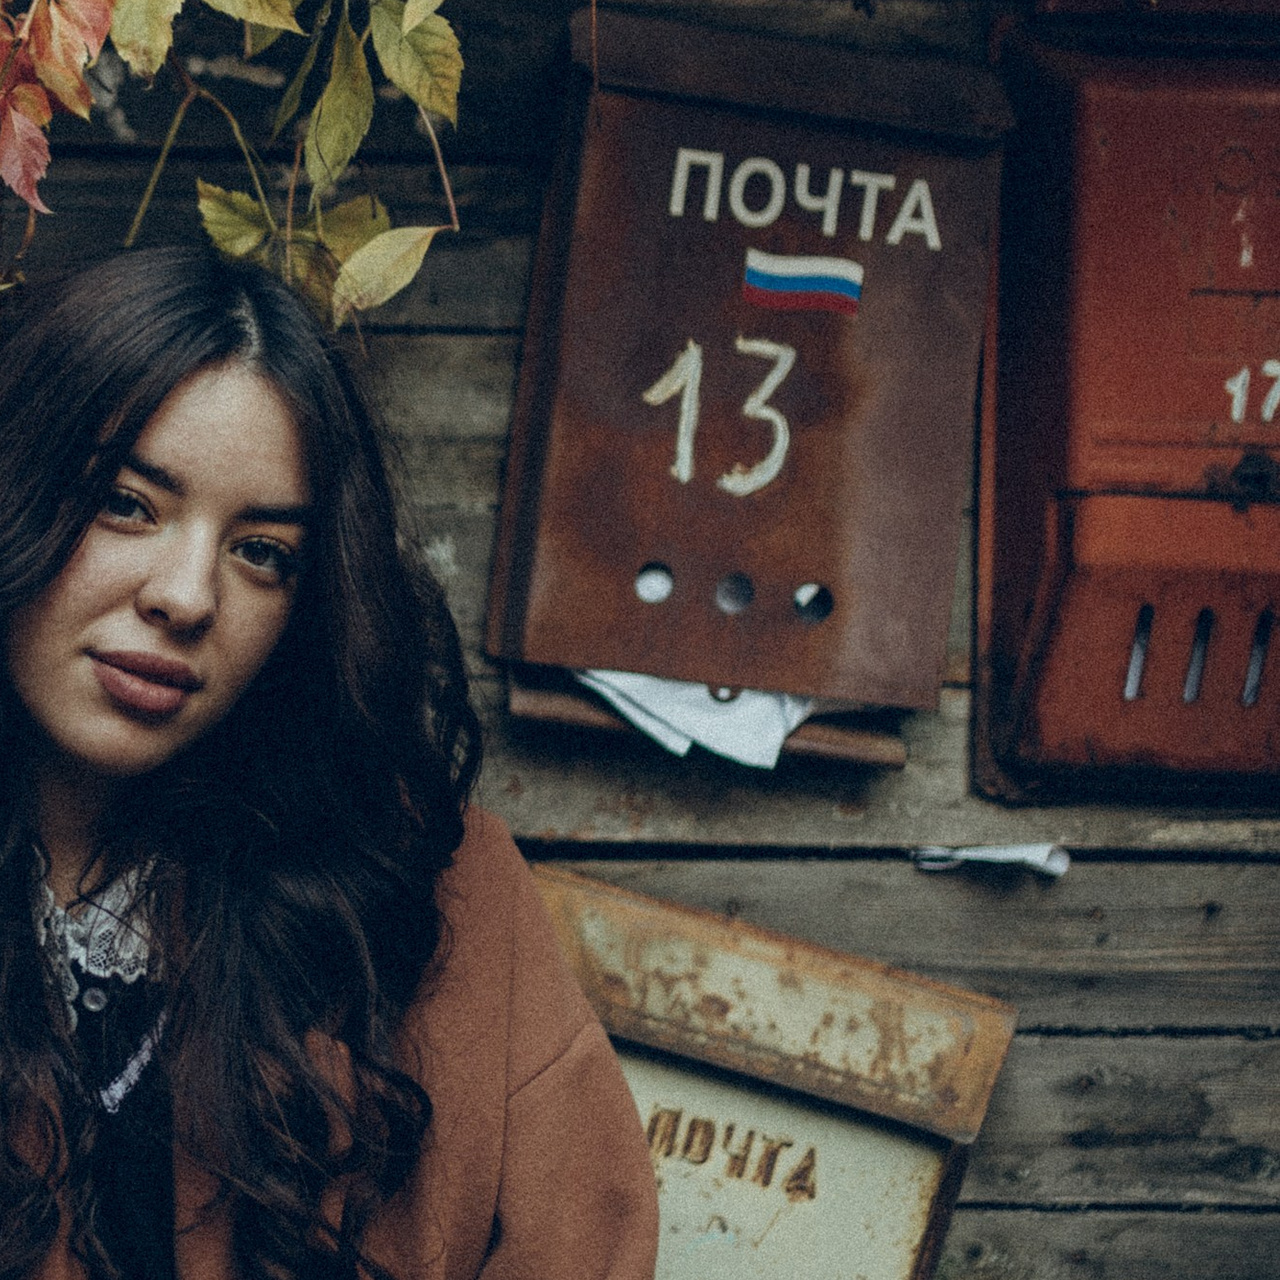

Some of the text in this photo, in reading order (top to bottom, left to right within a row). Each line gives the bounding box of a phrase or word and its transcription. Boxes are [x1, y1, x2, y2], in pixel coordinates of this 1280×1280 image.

[670, 147, 942, 251] ПОЧТА
[642, 336, 797, 497] 13
[646, 1105, 817, 1203] ПОЧТА
